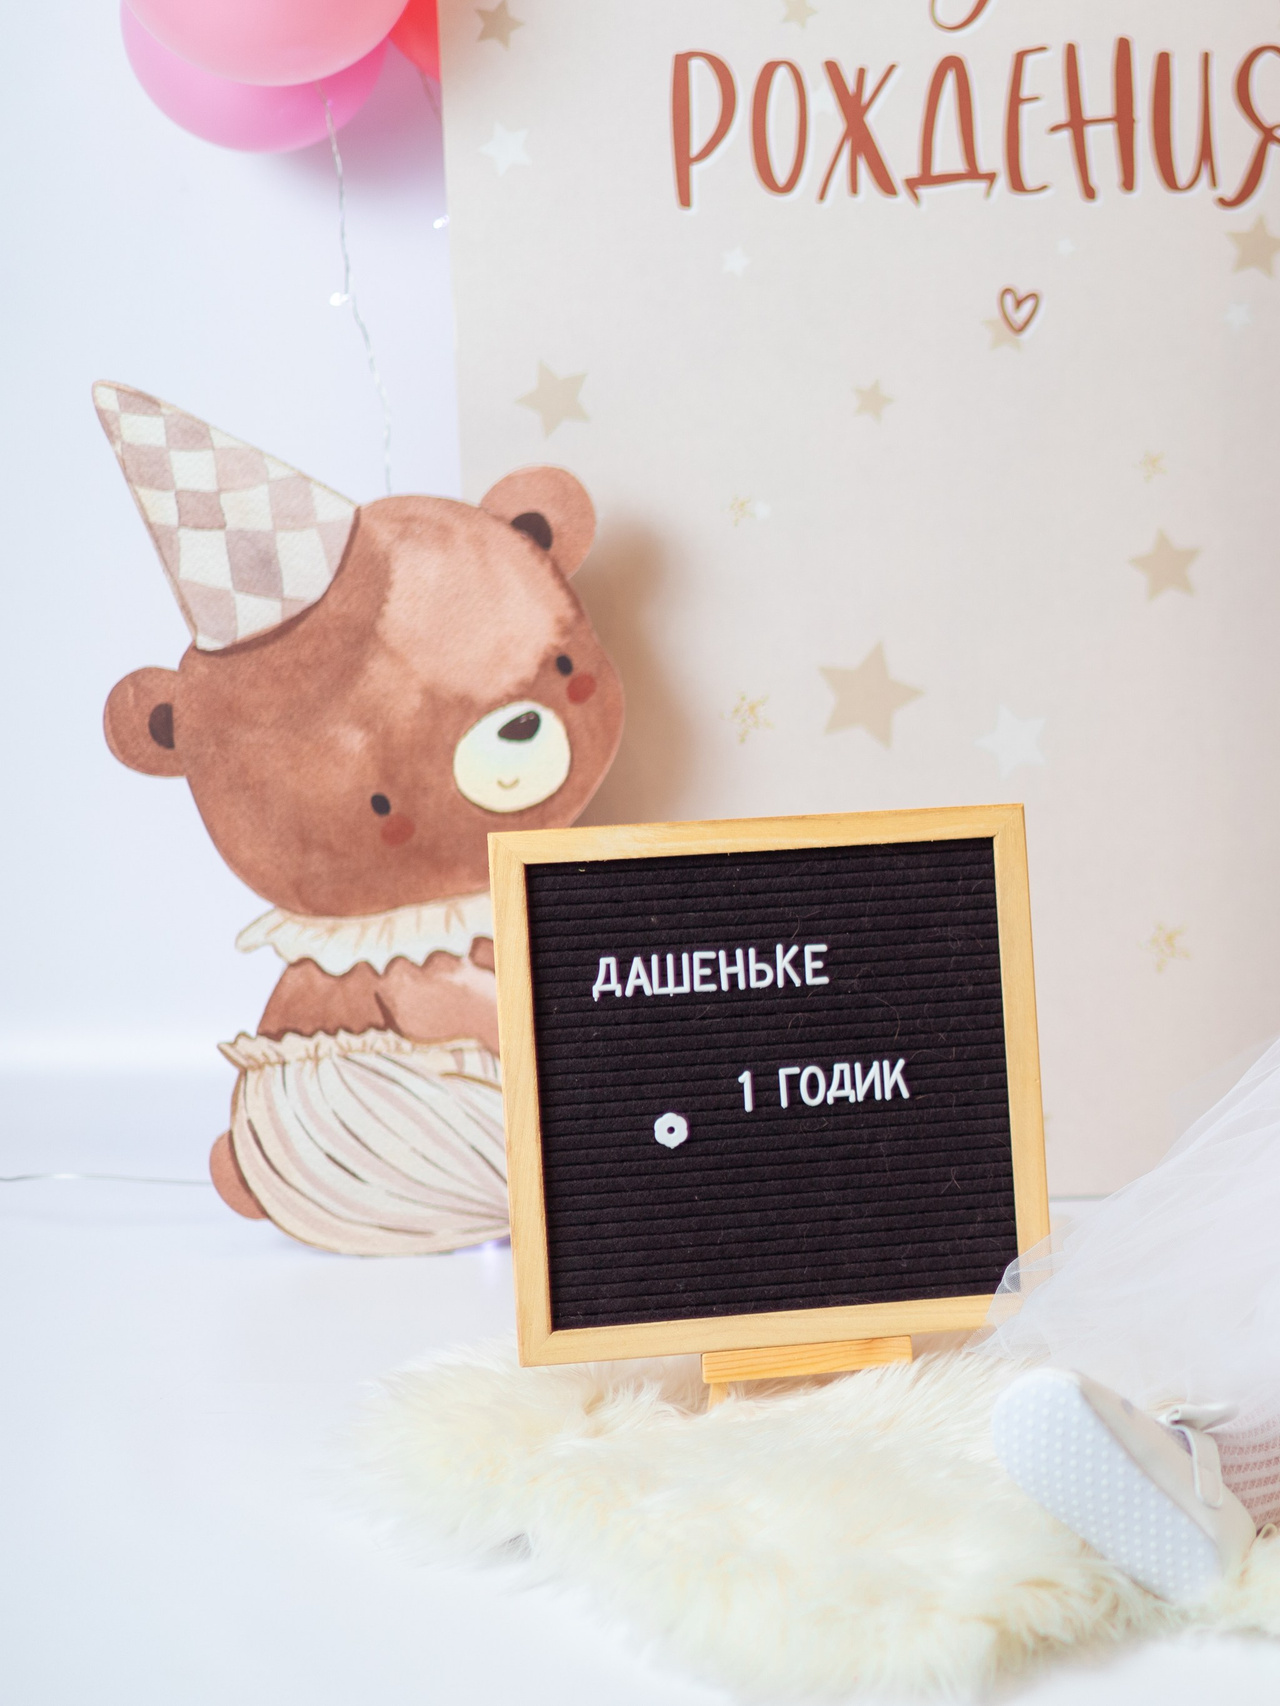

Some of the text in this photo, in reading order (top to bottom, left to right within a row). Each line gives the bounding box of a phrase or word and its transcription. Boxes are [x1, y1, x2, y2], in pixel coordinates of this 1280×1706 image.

[592, 943, 831, 1002] ДАШЕНЬКЕ
[738, 1058, 910, 1112] 1 ГОДИК
